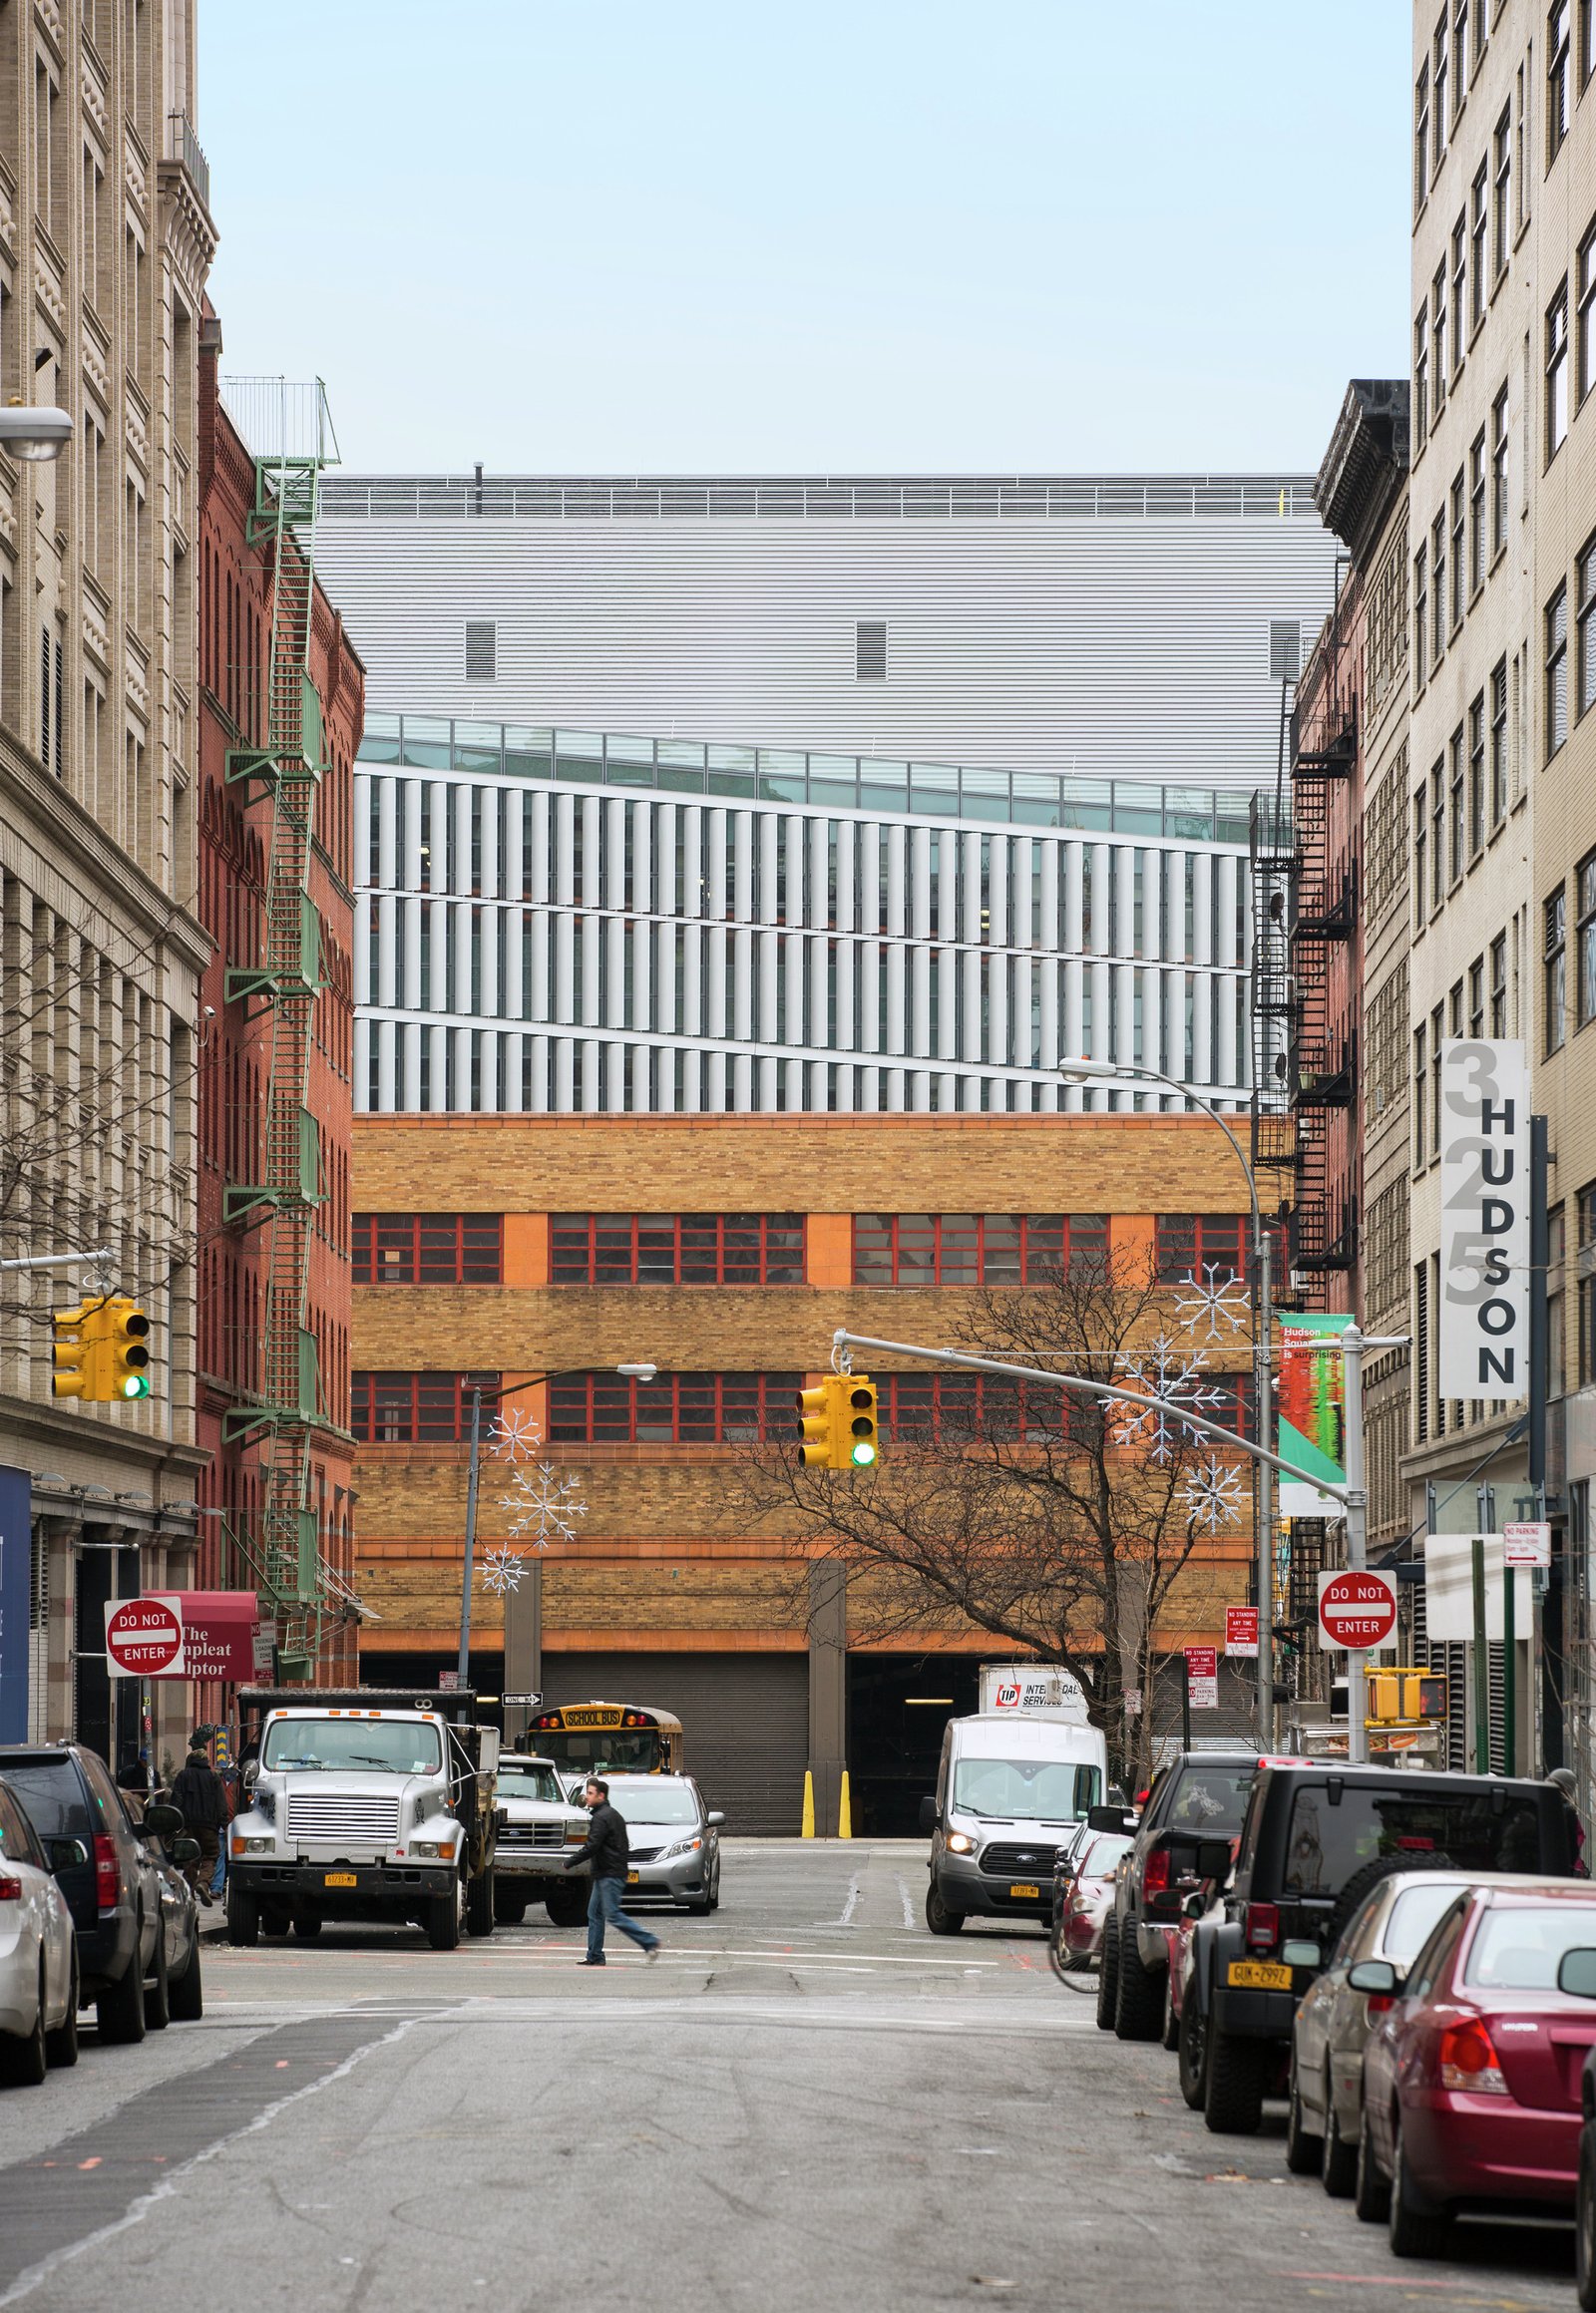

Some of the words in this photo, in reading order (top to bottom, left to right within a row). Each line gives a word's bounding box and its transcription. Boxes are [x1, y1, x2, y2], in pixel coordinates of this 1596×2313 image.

[1442, 1042, 1499, 1306] 325
[1477, 1098, 1516, 1383] HUDSON
[1284, 1327, 1321, 1337] Hudson
[1284, 1349, 1293, 1358] is
[1294, 1350, 1342, 1359] surprising
[1331, 1587, 1350, 1600] DO
[1358, 1587, 1385, 1599] NOT
[120, 1616, 138, 1628] DO
[142, 1613, 168, 1626] NOT
[182, 1626, 208, 1641] The
[251, 1624, 260, 1635] NO
[1337, 1621, 1380, 1634] ENTER
[124, 1647, 166, 1661] ENTER
[1000, 1690, 1015, 1702] TIP
[1025, 1685, 1078, 1695] INTEDAL
[567, 1712, 598, 1726] SCHOOL
[601, 1711, 618, 1725] BUS
